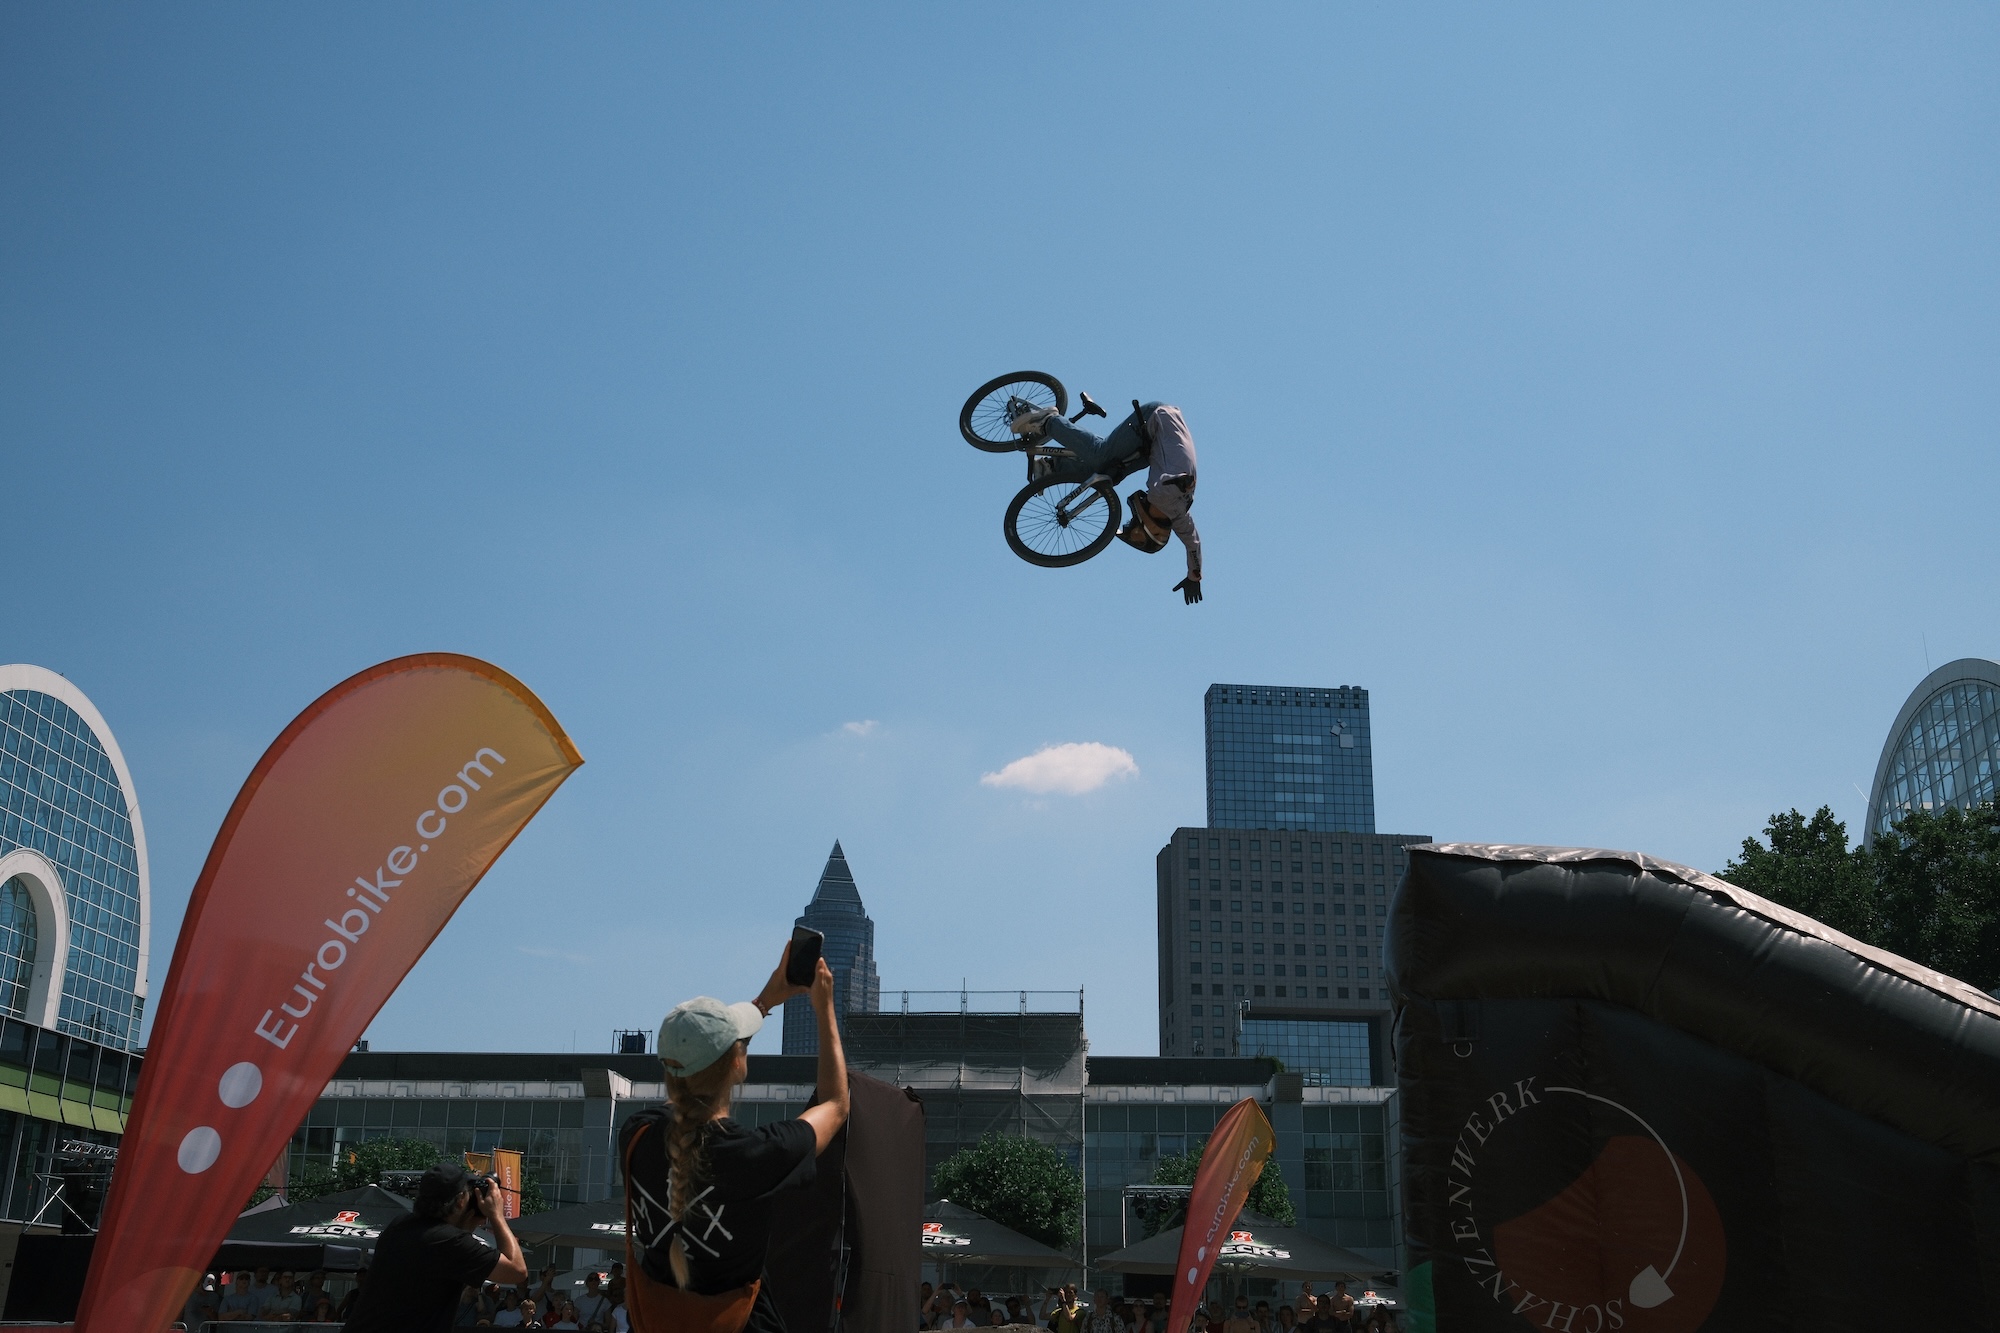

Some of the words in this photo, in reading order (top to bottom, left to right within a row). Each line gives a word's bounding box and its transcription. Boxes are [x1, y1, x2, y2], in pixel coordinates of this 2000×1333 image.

[254, 747, 506, 1050] Eurobike.com
[504, 1166, 513, 1219] bike.com
[1220, 1245, 1291, 1259] ECK'S
[1447, 1076, 1625, 1333] SCHANZENWERK
